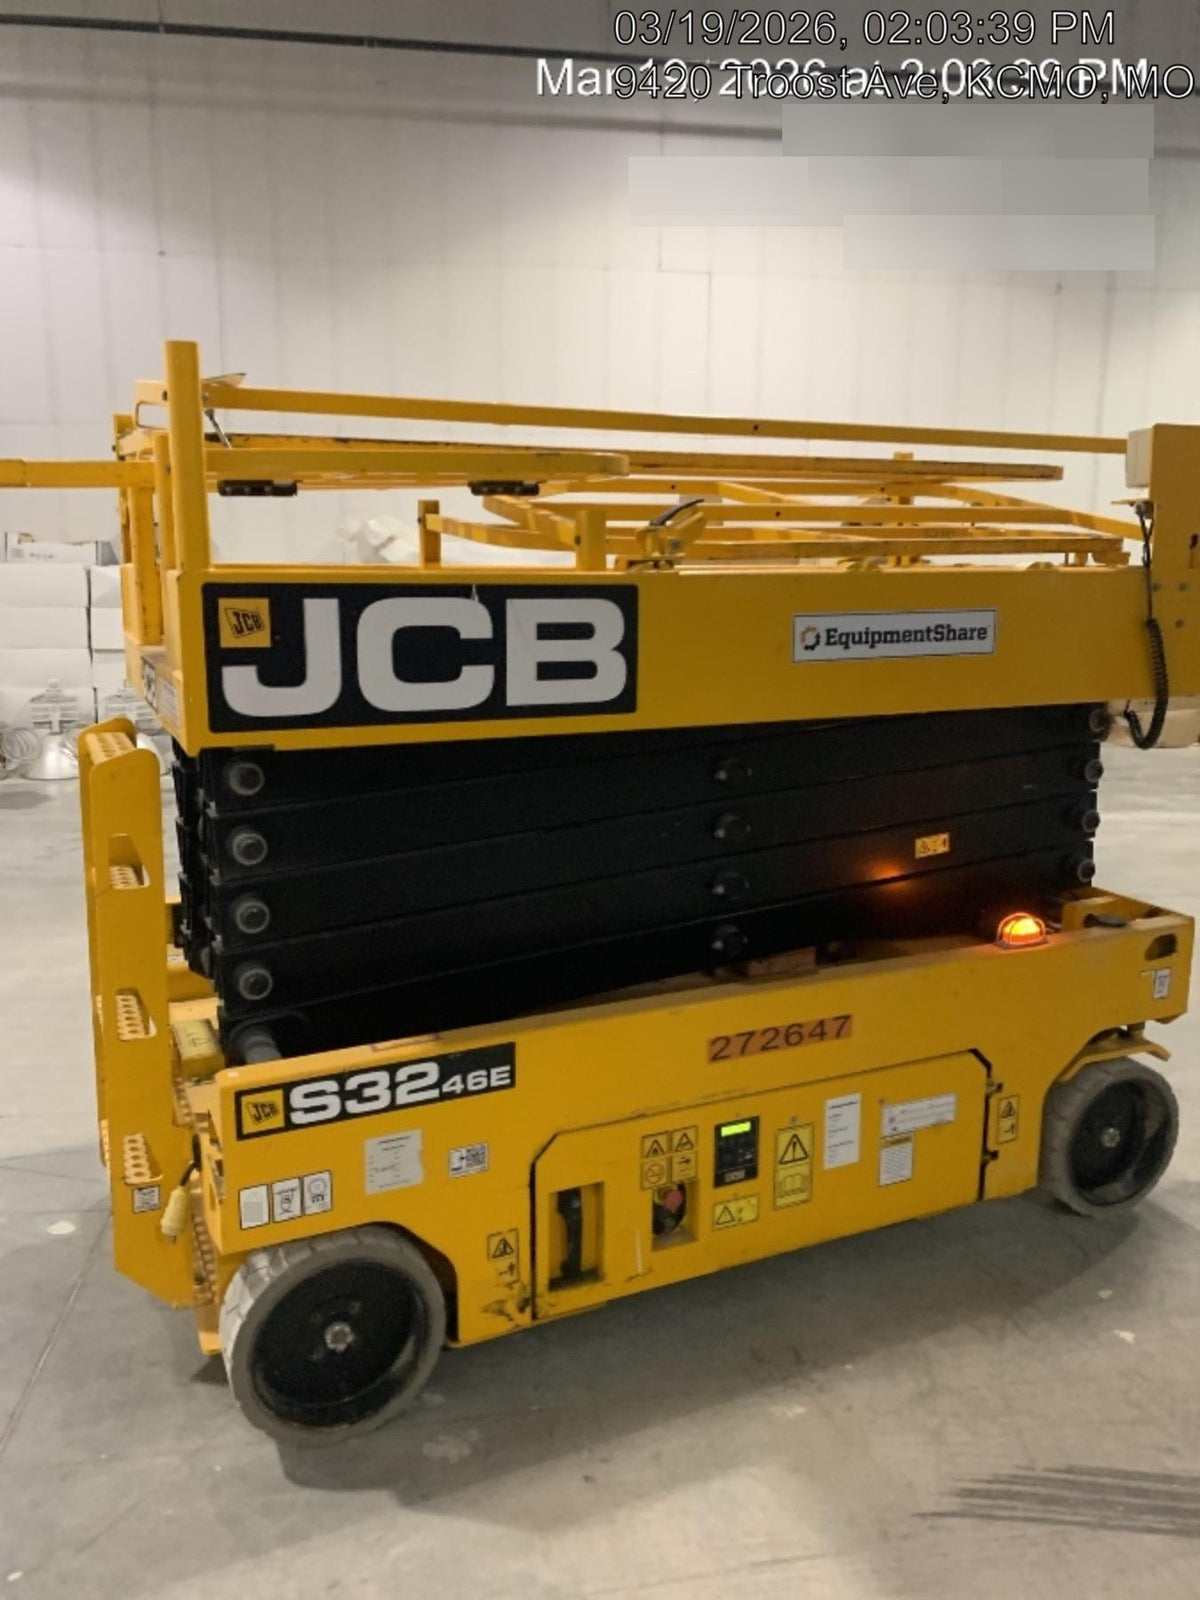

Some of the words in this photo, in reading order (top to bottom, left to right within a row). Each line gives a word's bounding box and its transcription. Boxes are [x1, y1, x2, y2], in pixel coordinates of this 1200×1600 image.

[231, 610, 264, 635] JCB
[825, 623, 988, 649] EquipmentShare
[221, 597, 627, 717] JCB
[709, 1014, 852, 1063] 272647
[289, 1061, 440, 1125] S32
[441, 1064, 511, 1095] 46E
